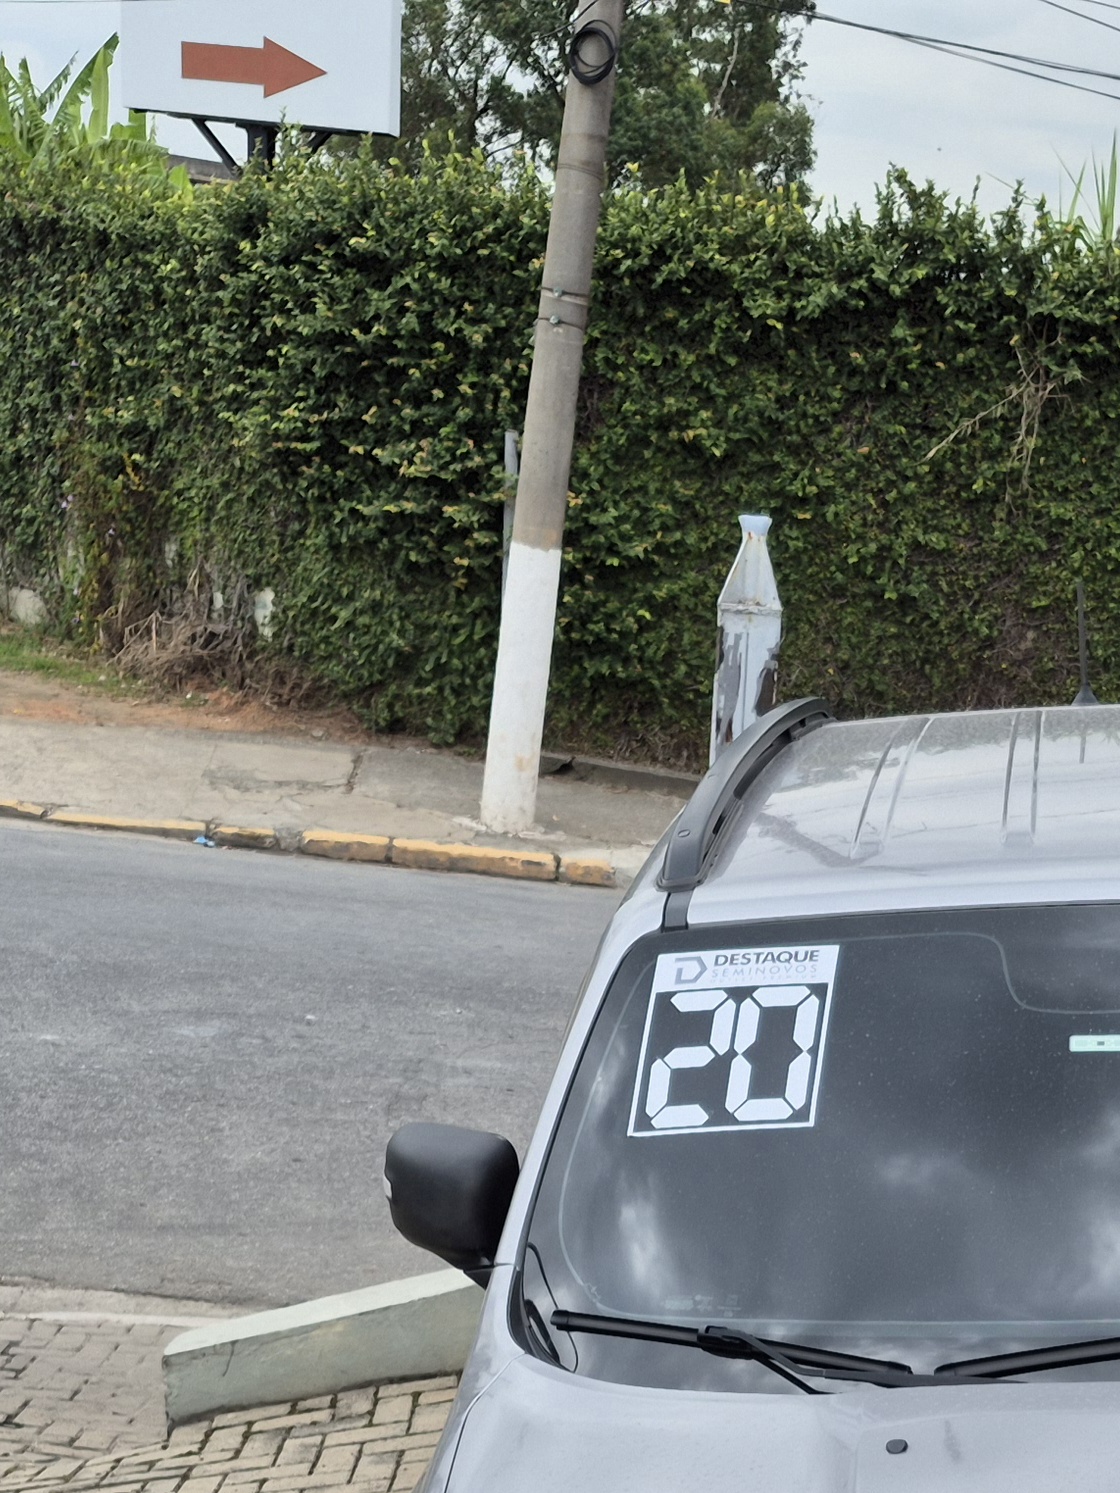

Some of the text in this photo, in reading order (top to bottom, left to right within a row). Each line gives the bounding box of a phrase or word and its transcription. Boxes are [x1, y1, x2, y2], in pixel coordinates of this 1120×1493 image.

[714, 949, 820, 967] DESTAQUE
[711, 963, 818, 979] SEMINOVOS
[645, 984, 820, 1129] 20
